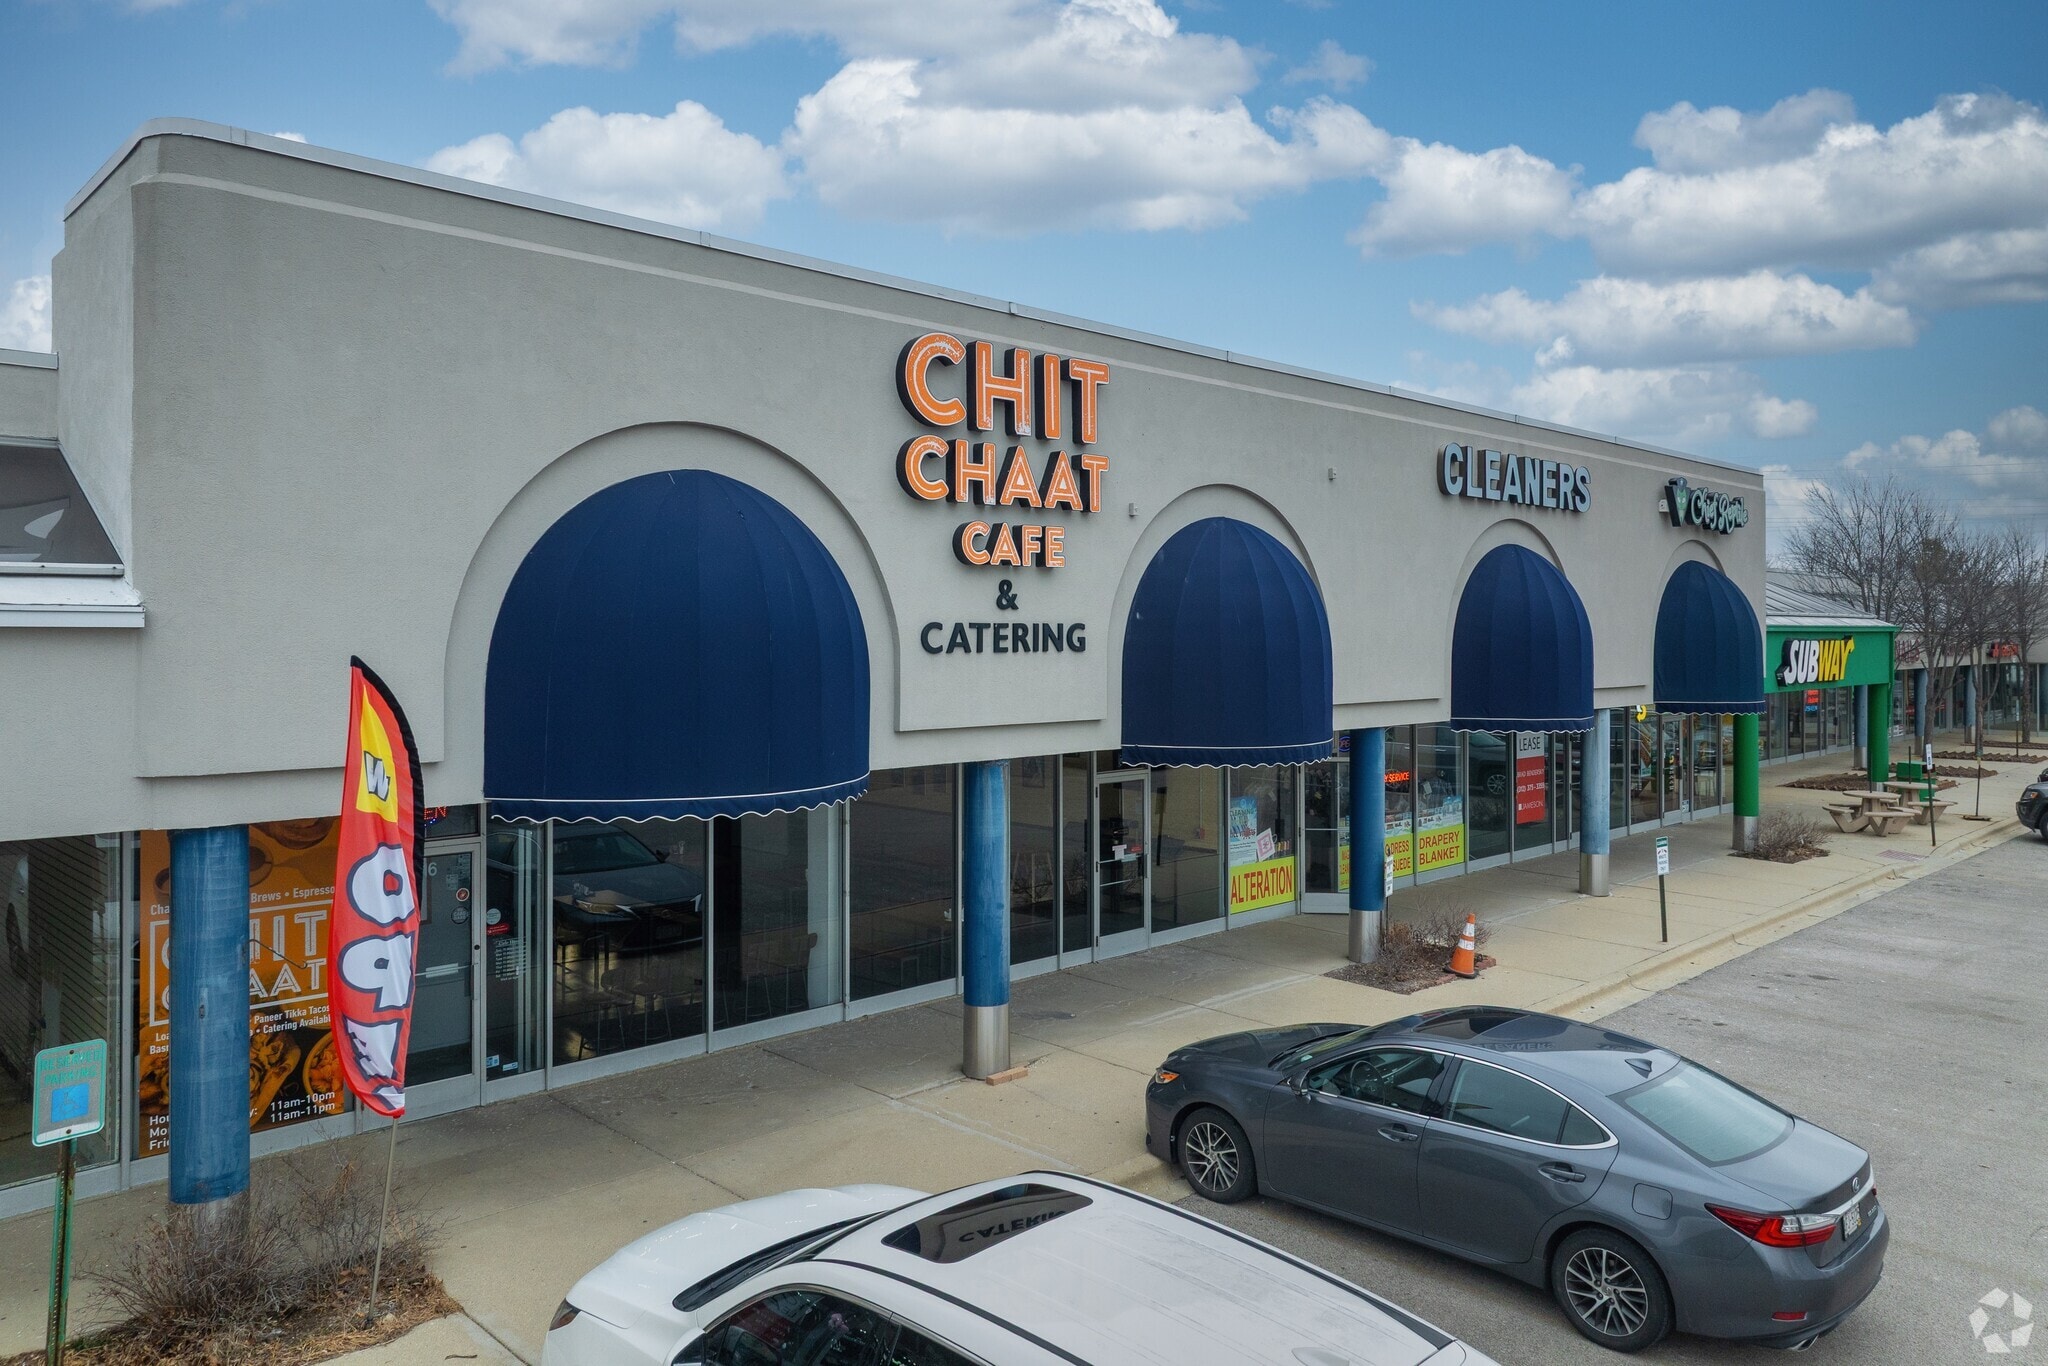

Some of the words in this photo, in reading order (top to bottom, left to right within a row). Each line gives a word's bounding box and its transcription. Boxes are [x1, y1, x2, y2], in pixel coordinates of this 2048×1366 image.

[899, 332, 1110, 444] CHIT
[899, 435, 1110, 512] CHAAT
[1440, 442, 1591, 513] CLEANERS
[956, 521, 1065, 568] CAFE
[996, 579, 1019, 610] &
[921, 622, 1086, 654] CATERING
[1782, 636, 1854, 686] SUBWAY
[1519, 736, 1541, 751] LEASE
[424, 806, 447, 820] EN
[1419, 830, 1460, 850] DRAPERY
[1419, 846, 1460, 865] BLANKET
[1230, 864, 1293, 905] ALTERATION
[150, 904, 170, 916] Cha
[250, 891, 281, 903] Brews
[292, 885, 335, 899] Espresso
[253, 1010, 283, 1024] Paneer
[285, 1007, 307, 1019] Tikka
[263, 1018, 297, 1034] Catering
[299, 1013, 331, 1027] Availabl
[270, 1091, 335, 1112] 11am-10pm
[270, 1102, 335, 1124] 11am-11pm
